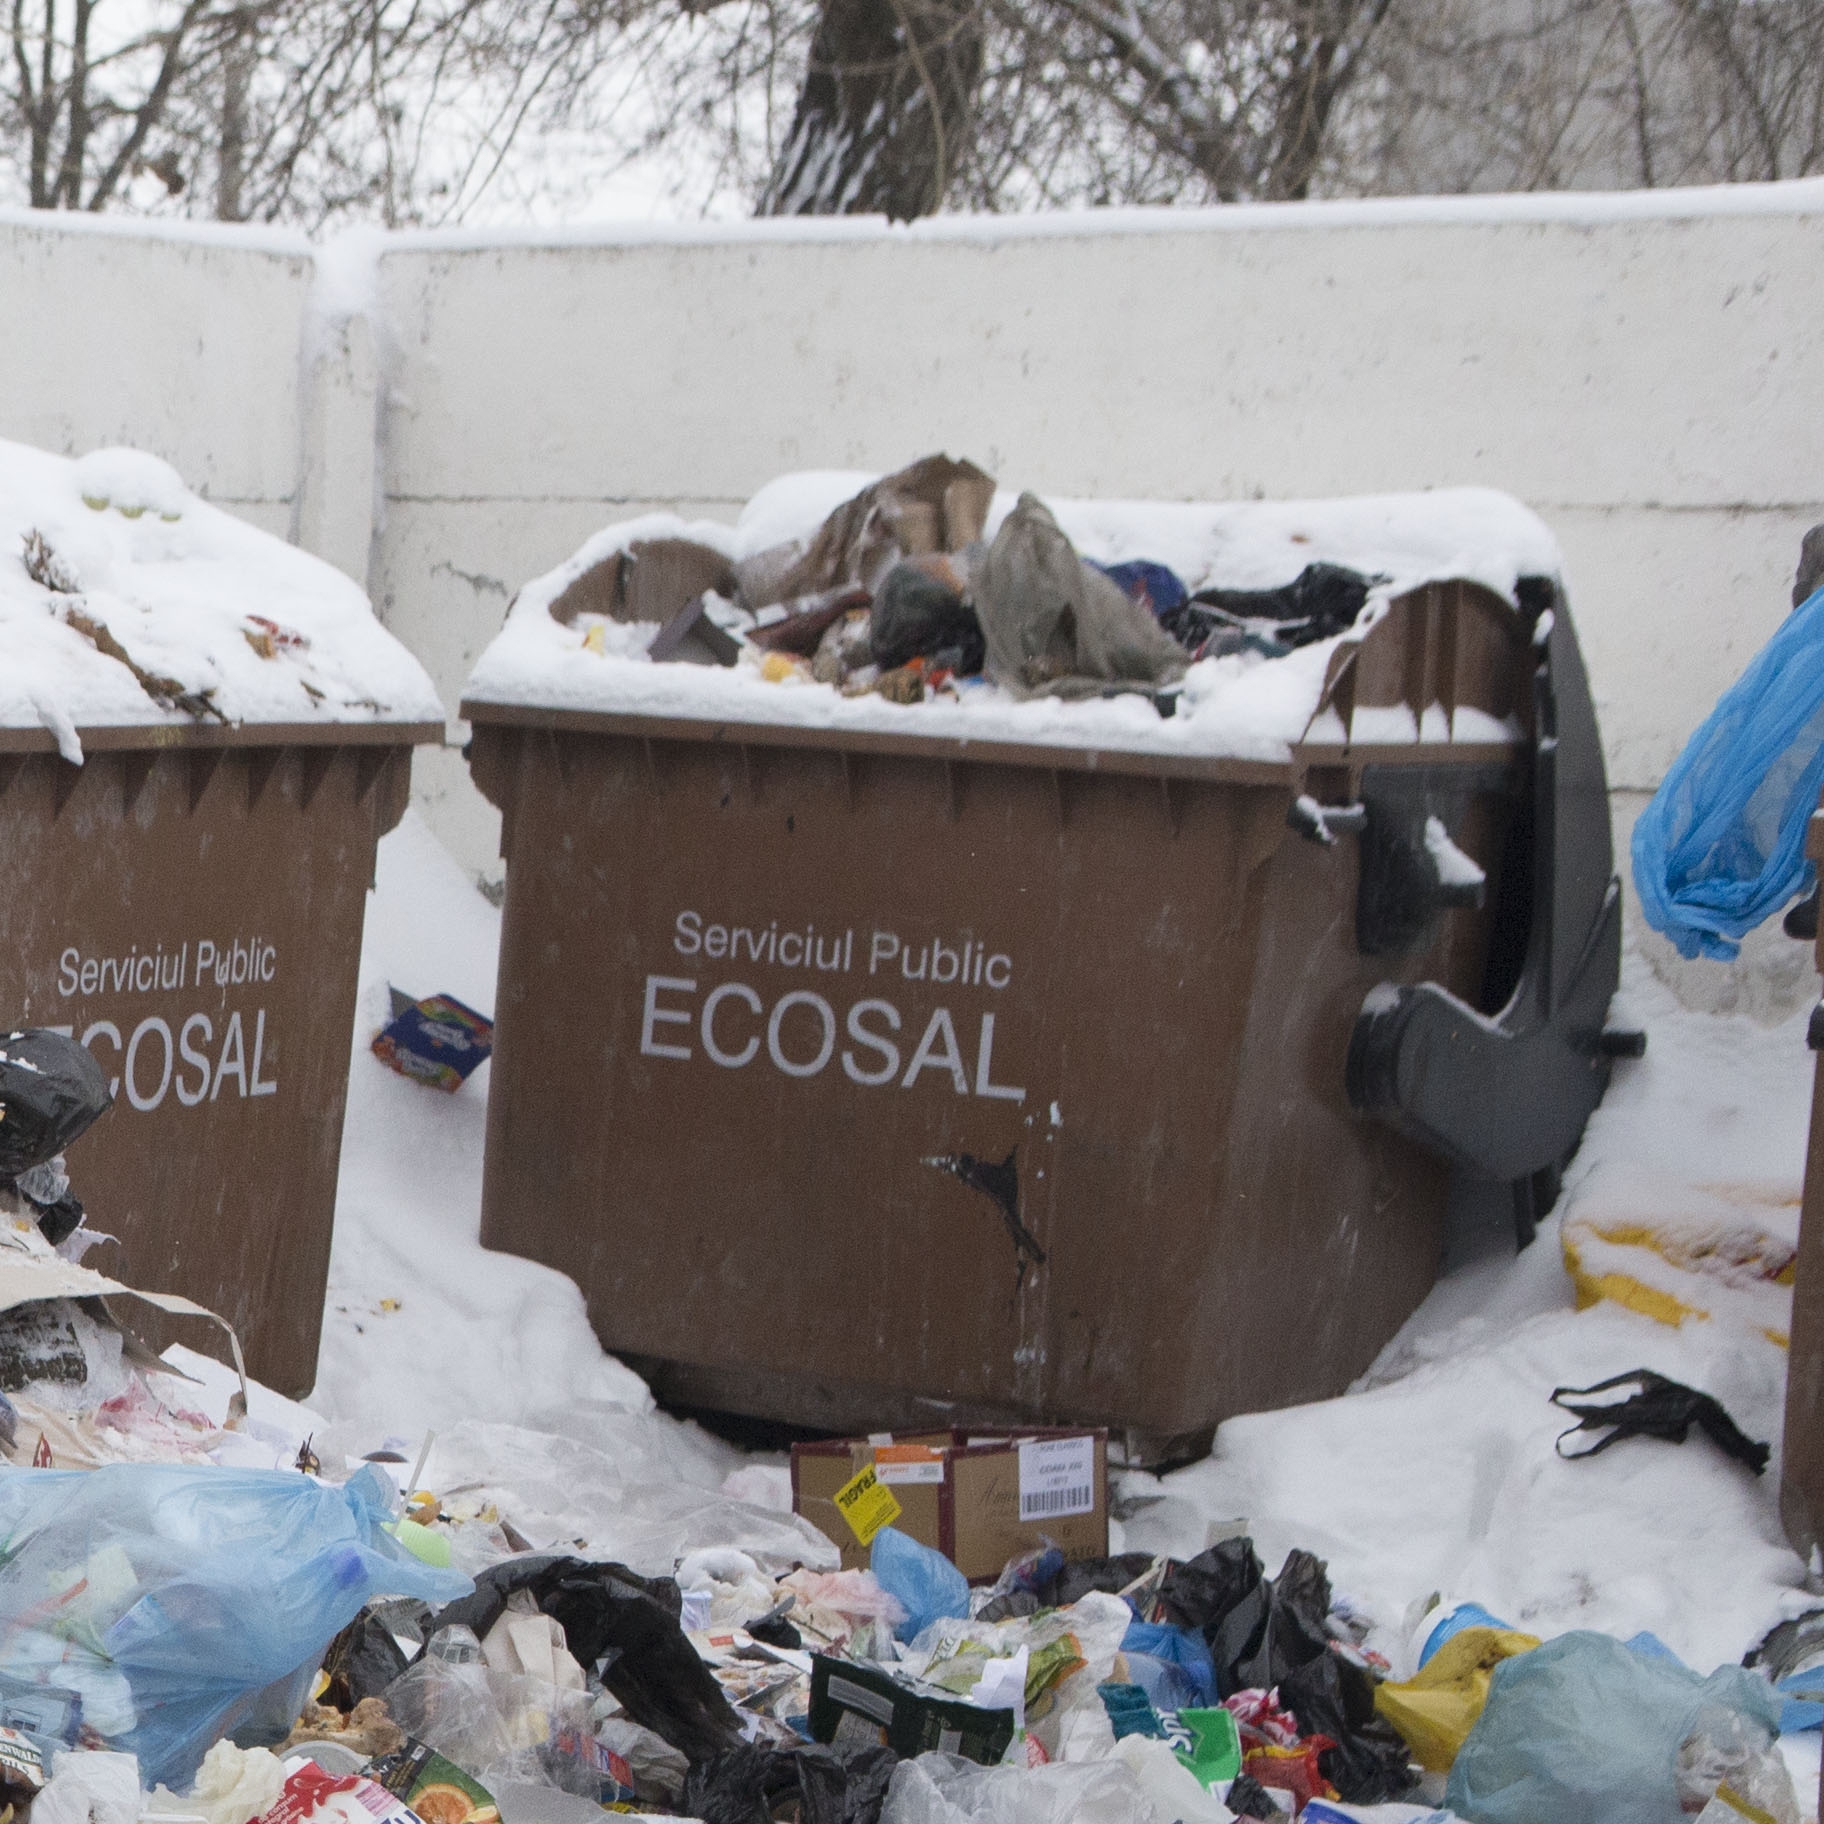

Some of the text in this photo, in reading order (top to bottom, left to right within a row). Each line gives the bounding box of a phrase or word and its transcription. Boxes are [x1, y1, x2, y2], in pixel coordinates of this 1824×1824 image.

[57, 935, 277, 998] Serviciul Public
[672, 910, 1014, 989] Serviciul Public
[50, 1008, 279, 1112] COSAL
[639, 974, 1028, 1102] ECOSAL
